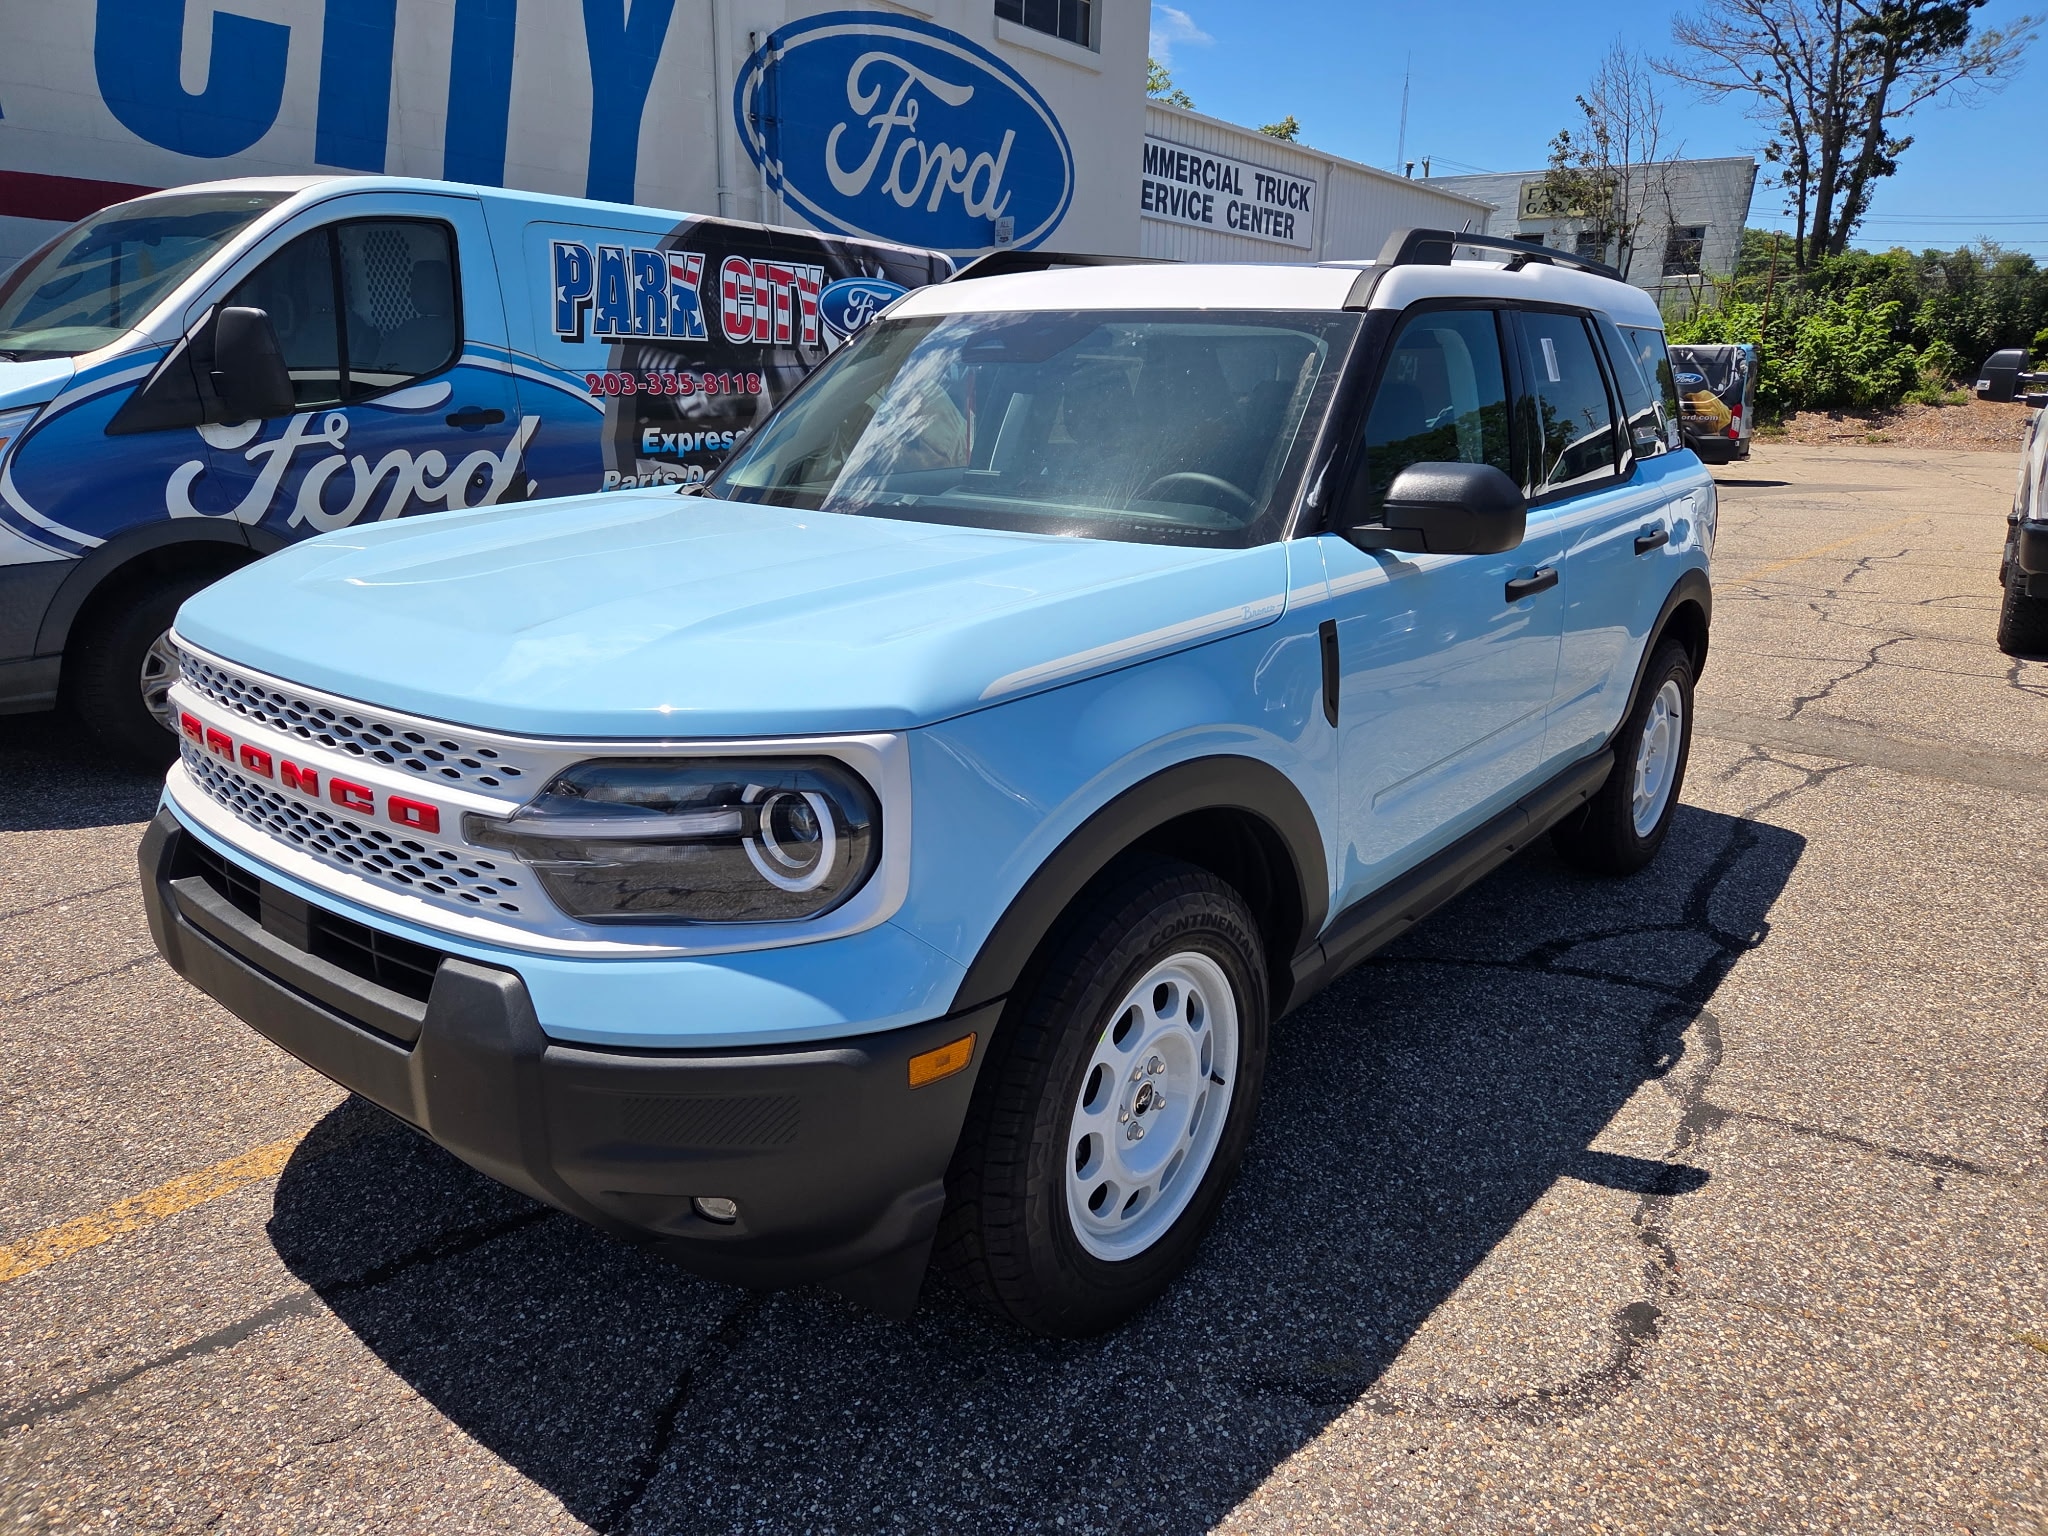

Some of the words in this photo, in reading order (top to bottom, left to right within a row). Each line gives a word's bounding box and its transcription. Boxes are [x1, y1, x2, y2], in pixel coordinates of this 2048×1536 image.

[825, 51, 1016, 221] Ford
[1254, 172, 1312, 212] TRUCK
[1525, 200, 1585, 216] GARA
[1226, 199, 1295, 240] CENTER
[549, 239, 708, 341] PARK
[720, 255, 825, 346] CITY
[585, 372, 762, 396] 203-335-8118
[165, 381, 542, 533] Ford
[602, 466, 678, 492] Parts
[1241, 605, 1276, 621] Bronco
[181, 711, 441, 835] BRONCO
[1149, 912, 1255, 960] CONTINENTAL
